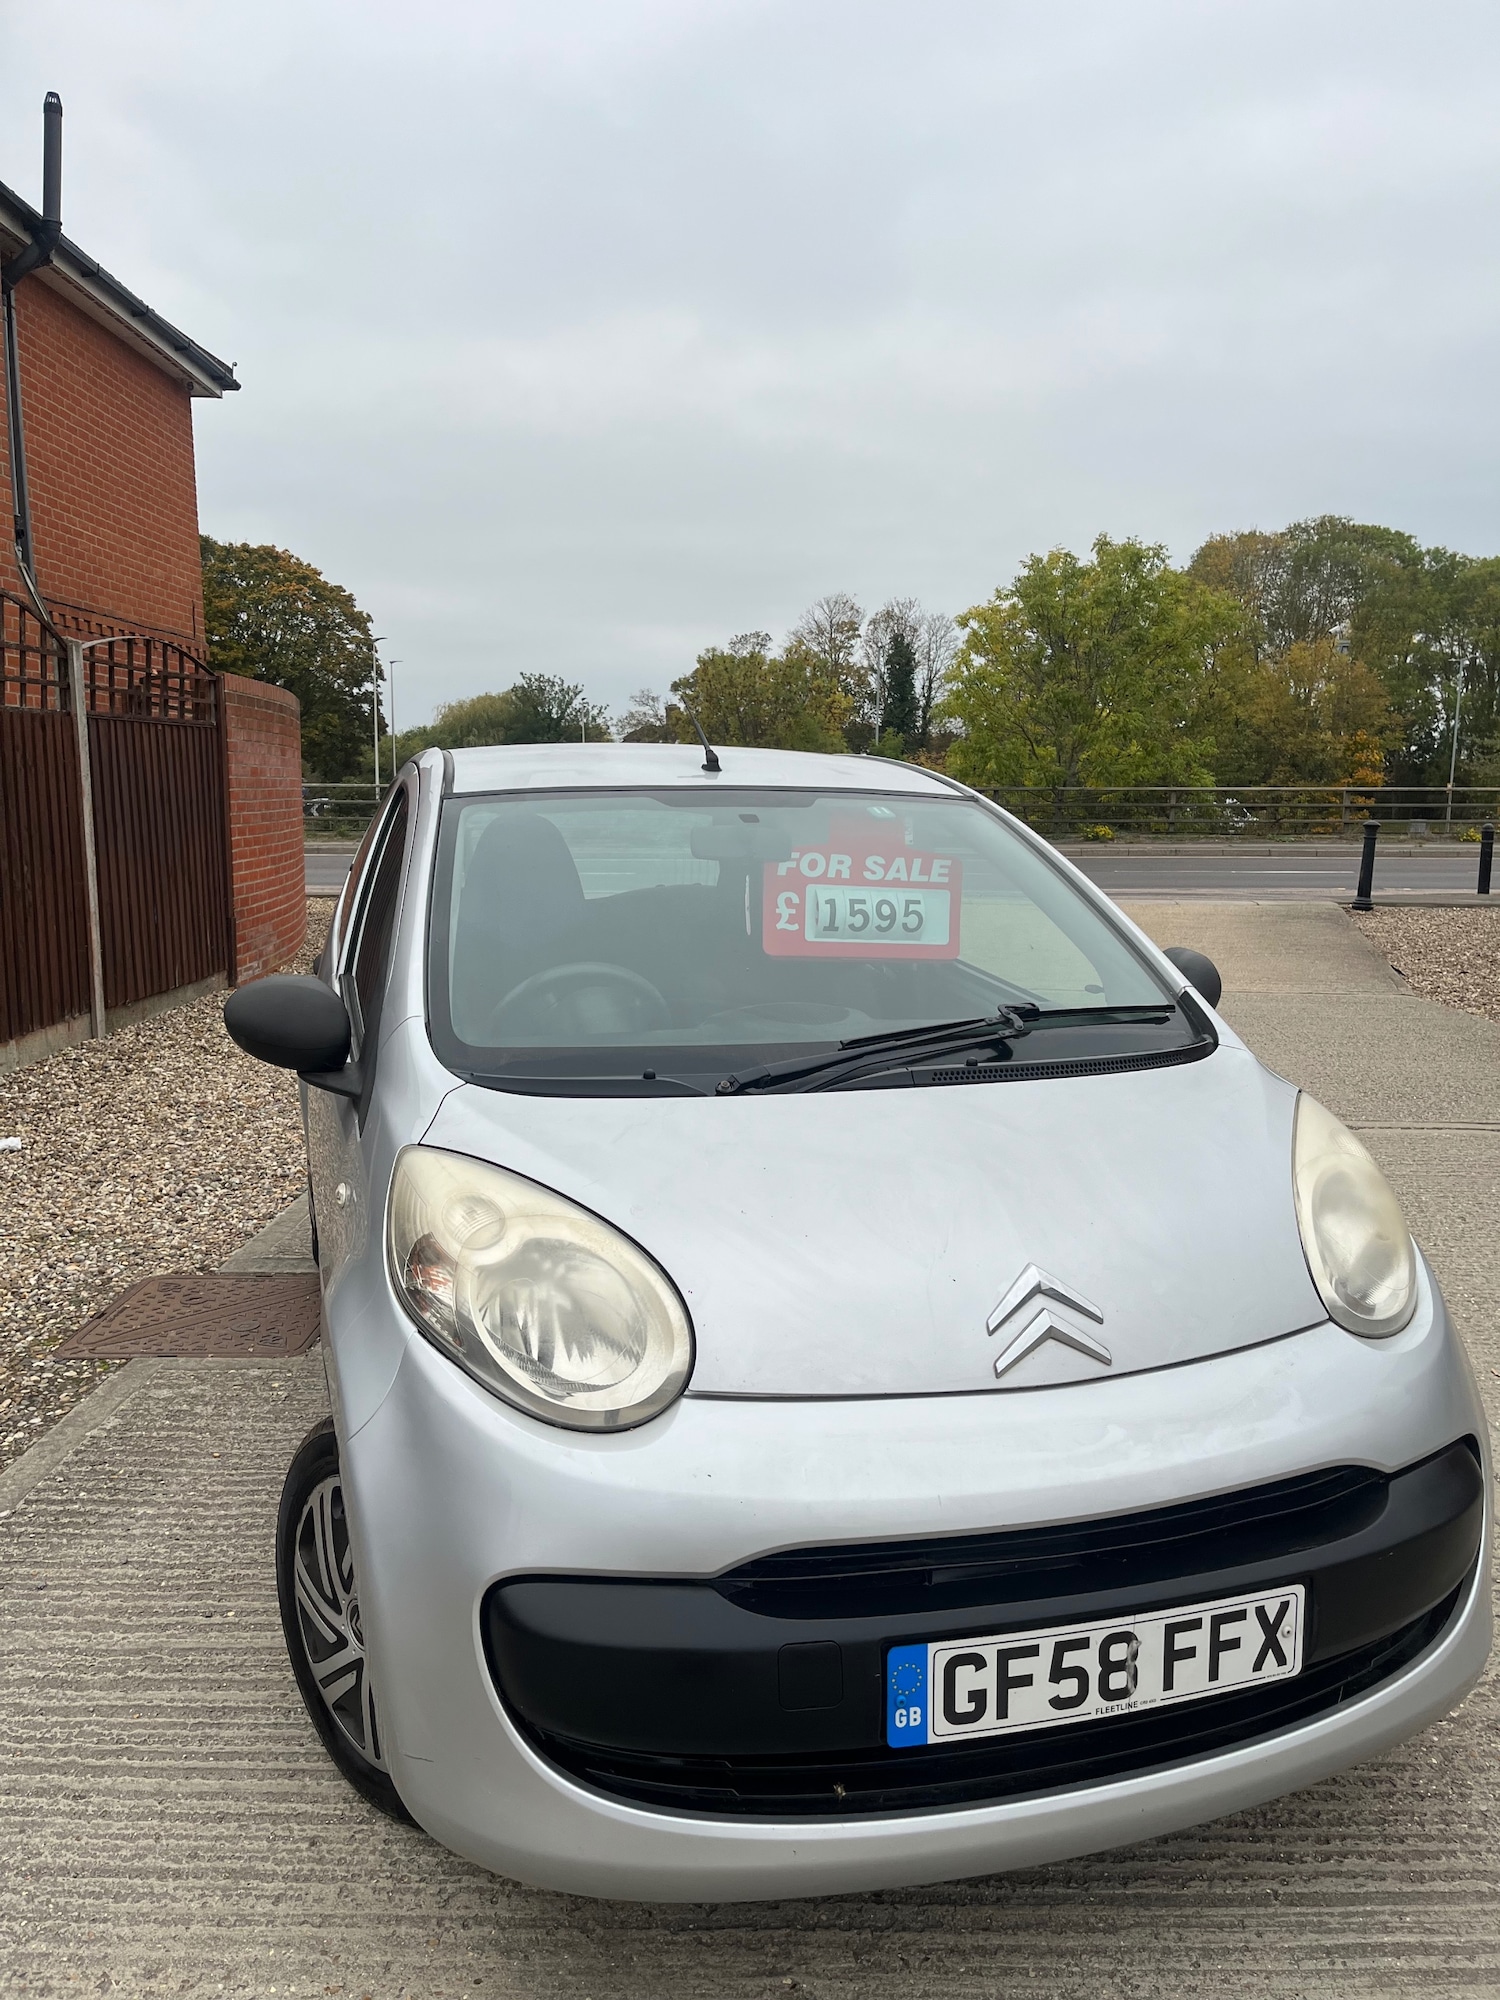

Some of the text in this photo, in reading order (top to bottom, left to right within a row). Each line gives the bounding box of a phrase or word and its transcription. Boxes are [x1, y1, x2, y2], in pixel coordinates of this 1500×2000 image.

[776, 852, 952, 883] FOR SALE
[775, 891, 924, 933] £ 1595
[942, 1600, 1291, 1726] GF58 FFX
[895, 1706, 922, 1729] GB
[1095, 1700, 1139, 1716] FLEETLINE
